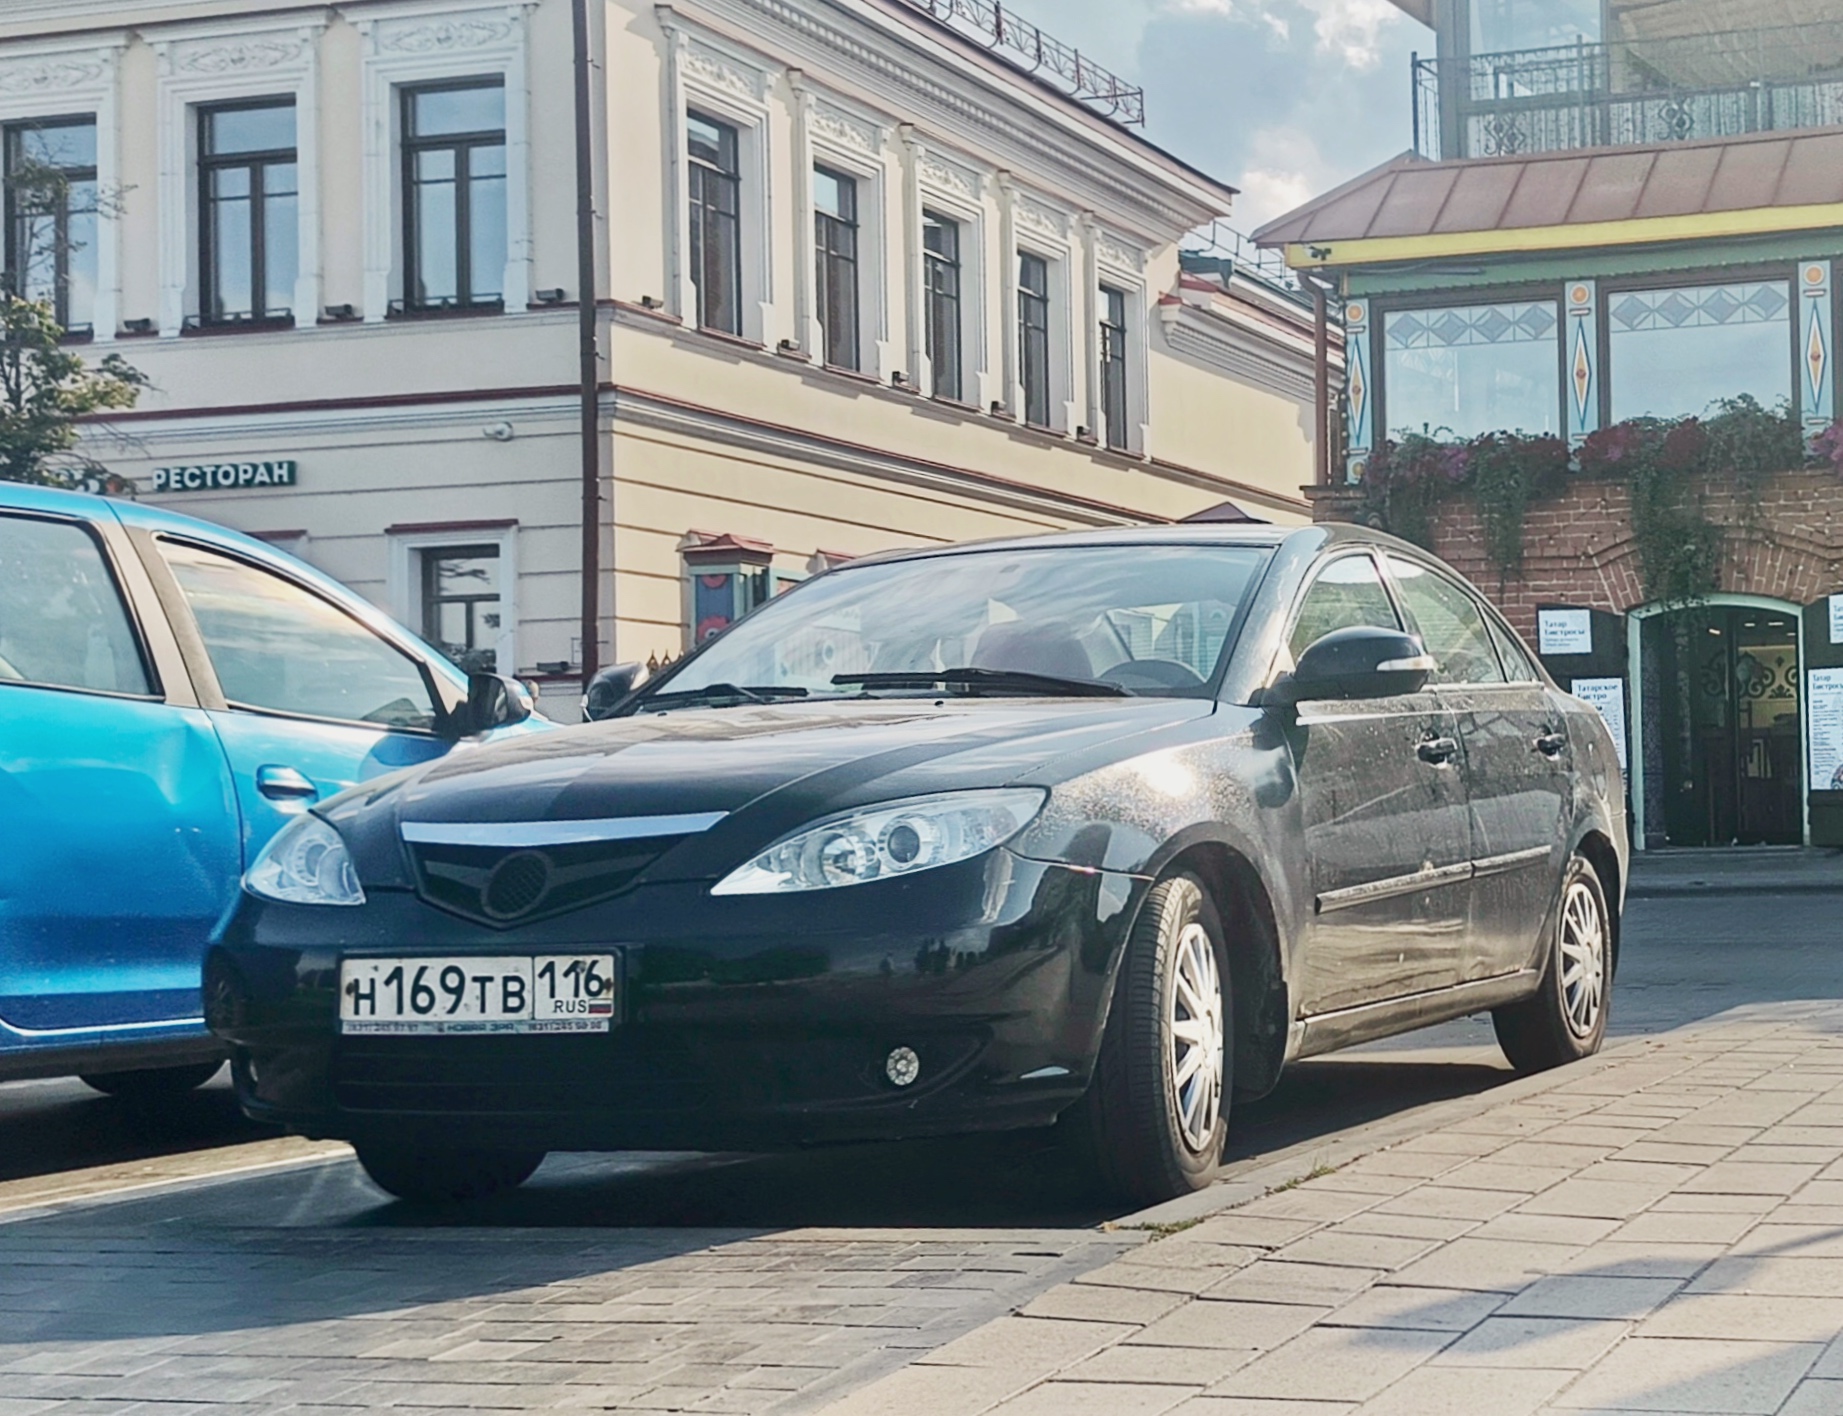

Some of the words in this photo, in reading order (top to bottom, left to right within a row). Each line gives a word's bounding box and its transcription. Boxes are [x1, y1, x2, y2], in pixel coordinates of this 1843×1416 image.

[152, 462, 290, 490] РЕСТОРАН
[537, 960, 605, 999] 116
[554, 1000, 587, 1013] RUS
